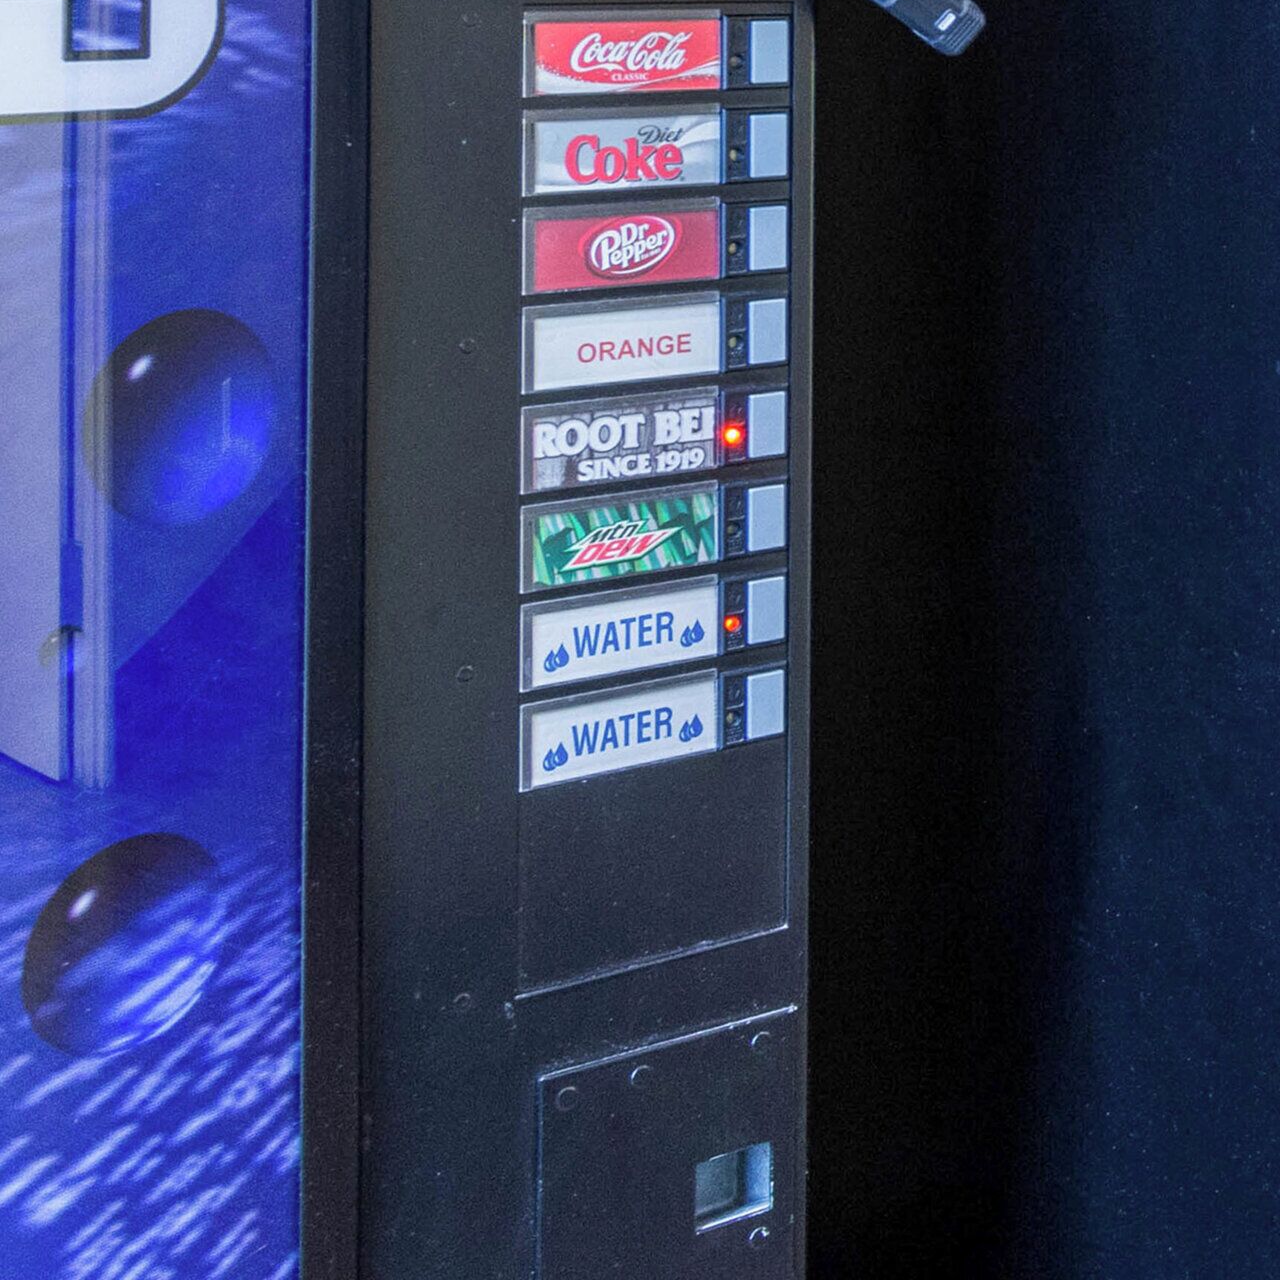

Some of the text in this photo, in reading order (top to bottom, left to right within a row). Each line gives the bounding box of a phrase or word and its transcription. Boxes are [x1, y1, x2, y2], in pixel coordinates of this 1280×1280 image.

[570, 31, 693, 73] Coca-Cola
[611, 72, 649, 82] CLASSIC
[637, 124, 685, 144] Diet
[564, 133, 684, 185] Coke
[600, 228, 668, 271] Pepper
[621, 222, 649, 244] Dr
[577, 333, 692, 363] ORANGE
[534, 413, 645, 459] ROOT
[577, 448, 705, 482] SINCE 1919
[573, 611, 674, 658] WATER
[571, 707, 673, 756] WATER
